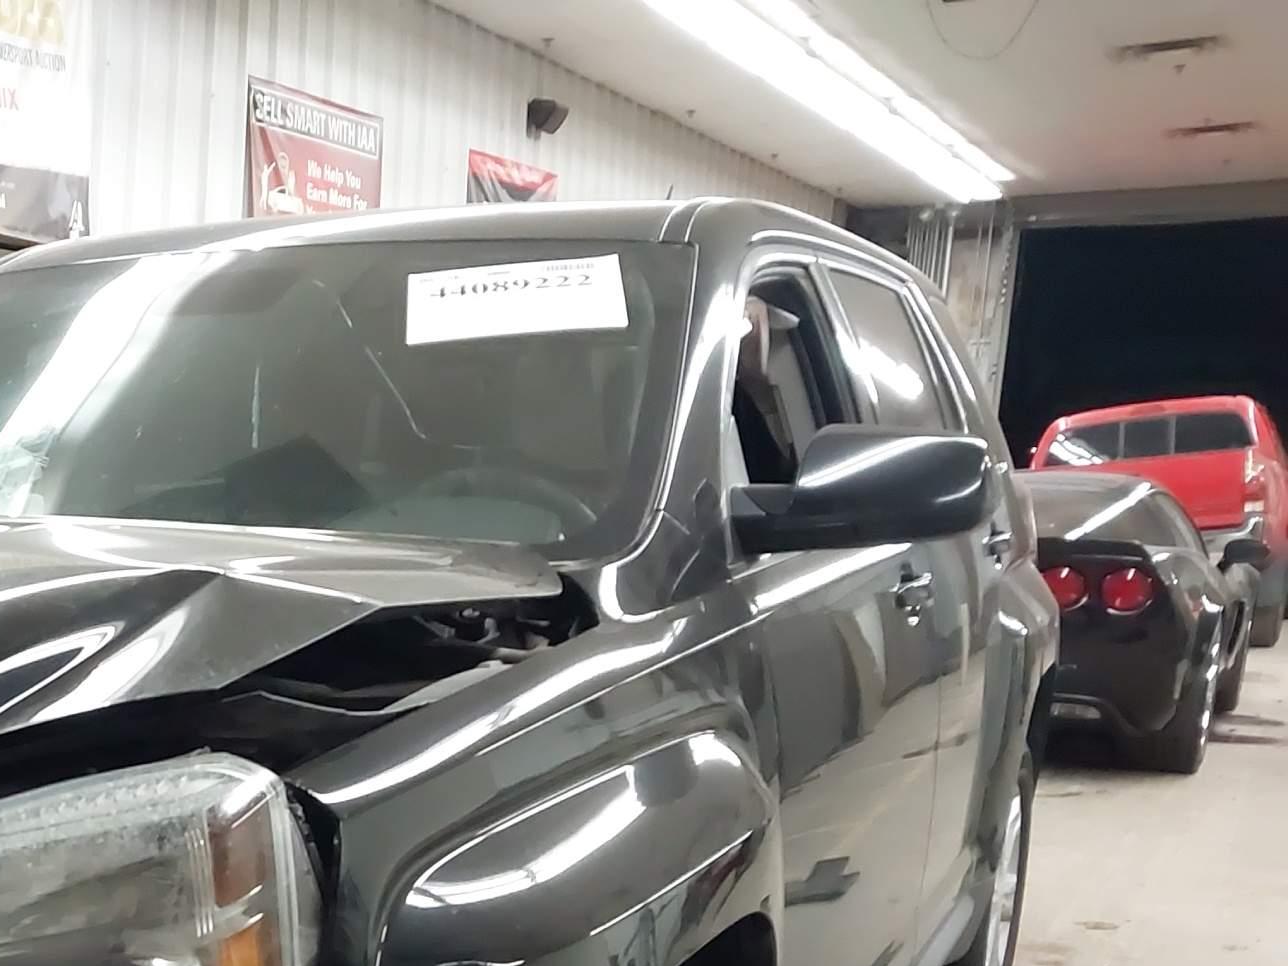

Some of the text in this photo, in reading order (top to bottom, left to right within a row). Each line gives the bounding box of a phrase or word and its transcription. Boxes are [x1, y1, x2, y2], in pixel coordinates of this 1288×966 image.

[255, 93, 376, 152] SELL SMART WITH IAA
[307, 159, 362, 190] We Help You
[306, 181, 327, 203] Earn
[329, 187, 352, 209] More
[353, 192, 369, 211] For
[429, 274, 593, 298] 44089222
